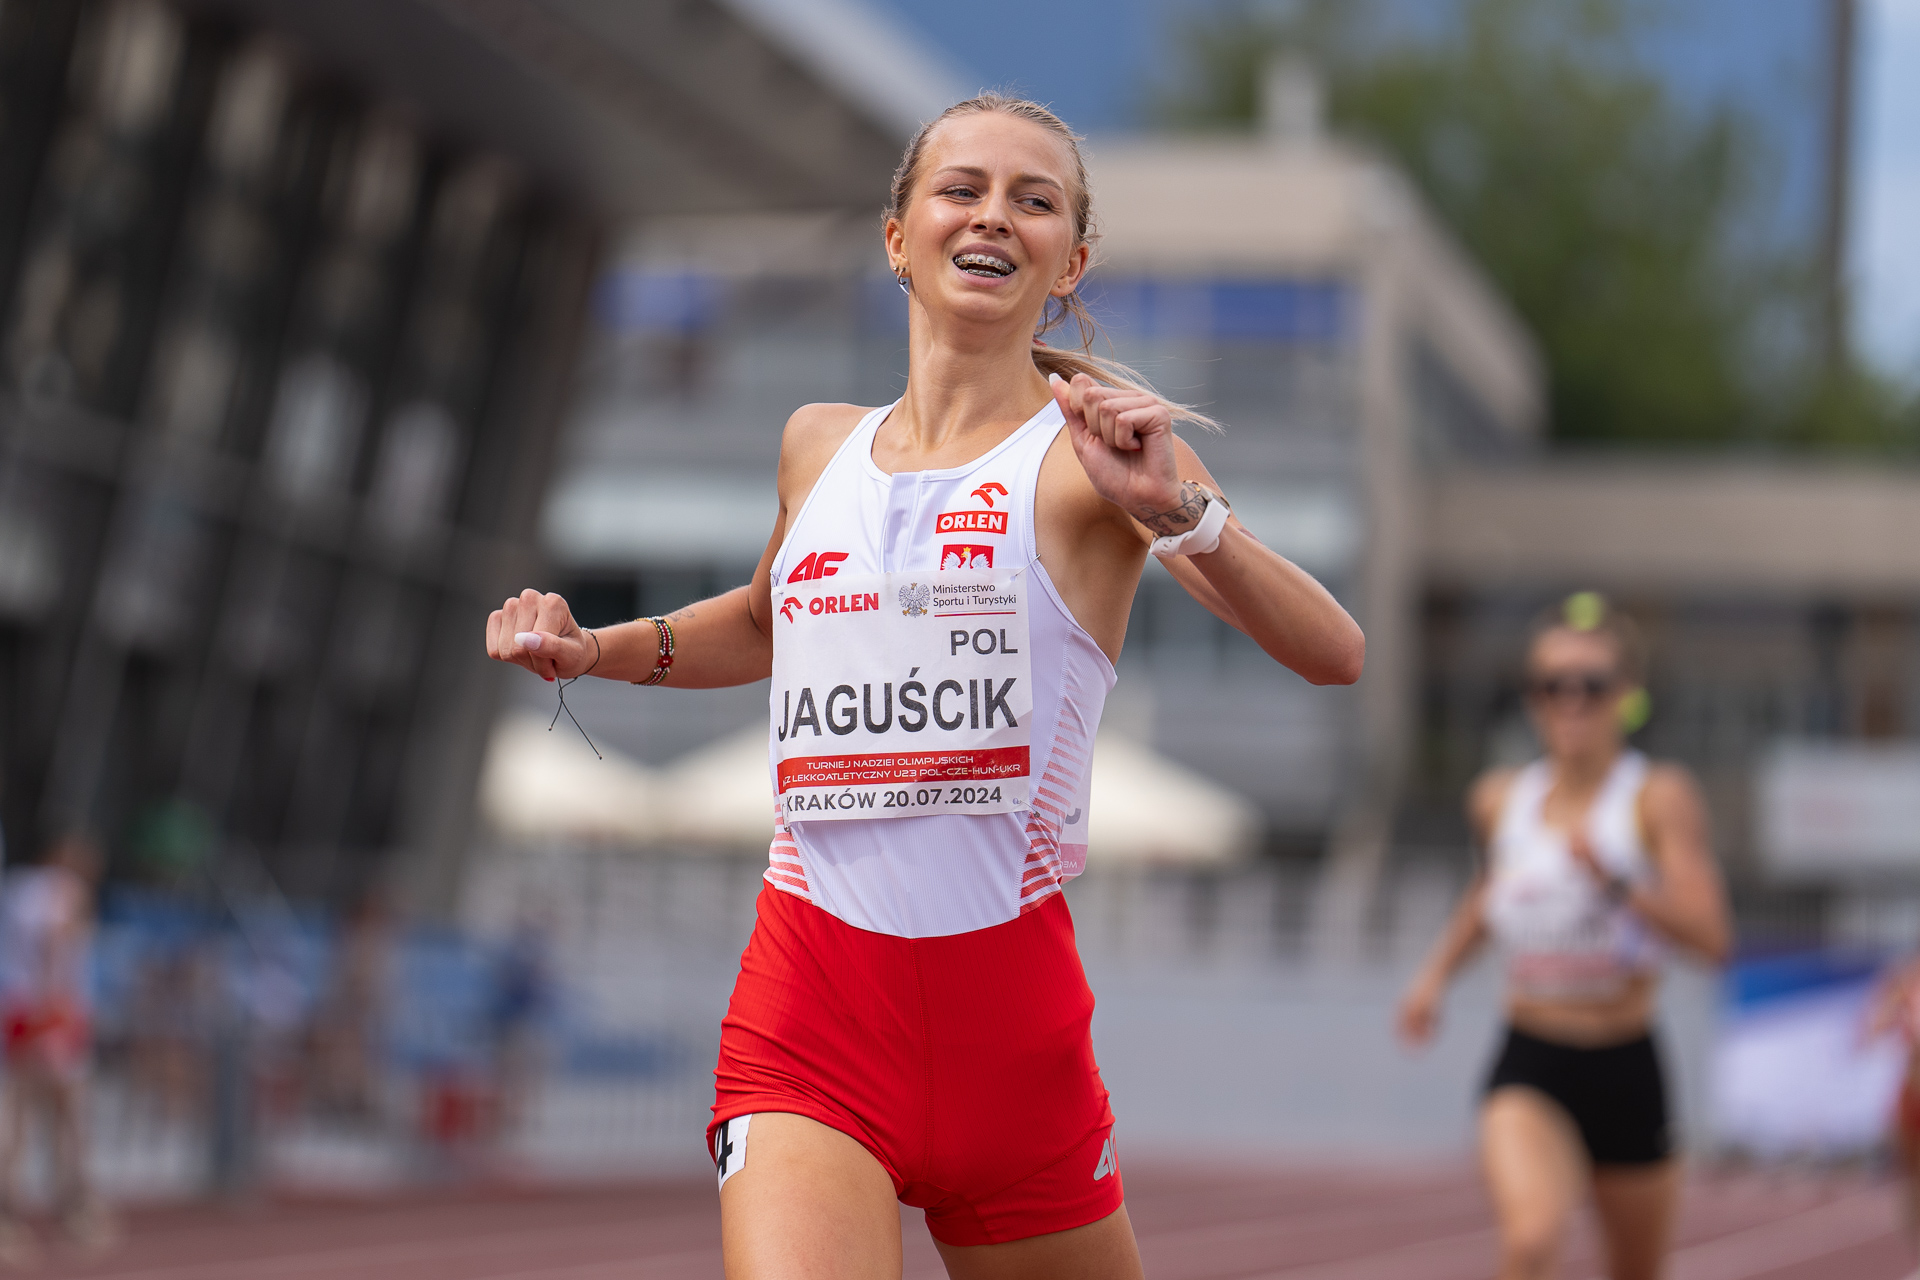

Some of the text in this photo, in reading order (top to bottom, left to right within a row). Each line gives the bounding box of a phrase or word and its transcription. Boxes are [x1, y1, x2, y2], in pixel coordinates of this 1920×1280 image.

[940, 514, 1003, 530] ORLEN
[932, 584, 996, 594] Ministerstwo
[809, 593, 879, 615] ORLEN
[933, 594, 1017, 608] Sportu i Turystyki
[950, 628, 1018, 656] POL
[778, 667, 1019, 742] JAGUŚCIK
[792, 770, 891, 782] LEKKOATLETYCZNY
[893, 769, 917, 778] U23
[919, 763, 1021, 777] POL-CZE-HUN-UKR
[806, 756, 974, 770] TURNIEJ NADZIEI OLIMPIJSKICH
[786, 786, 1002, 812] KRAKÓW 20.07.2024
